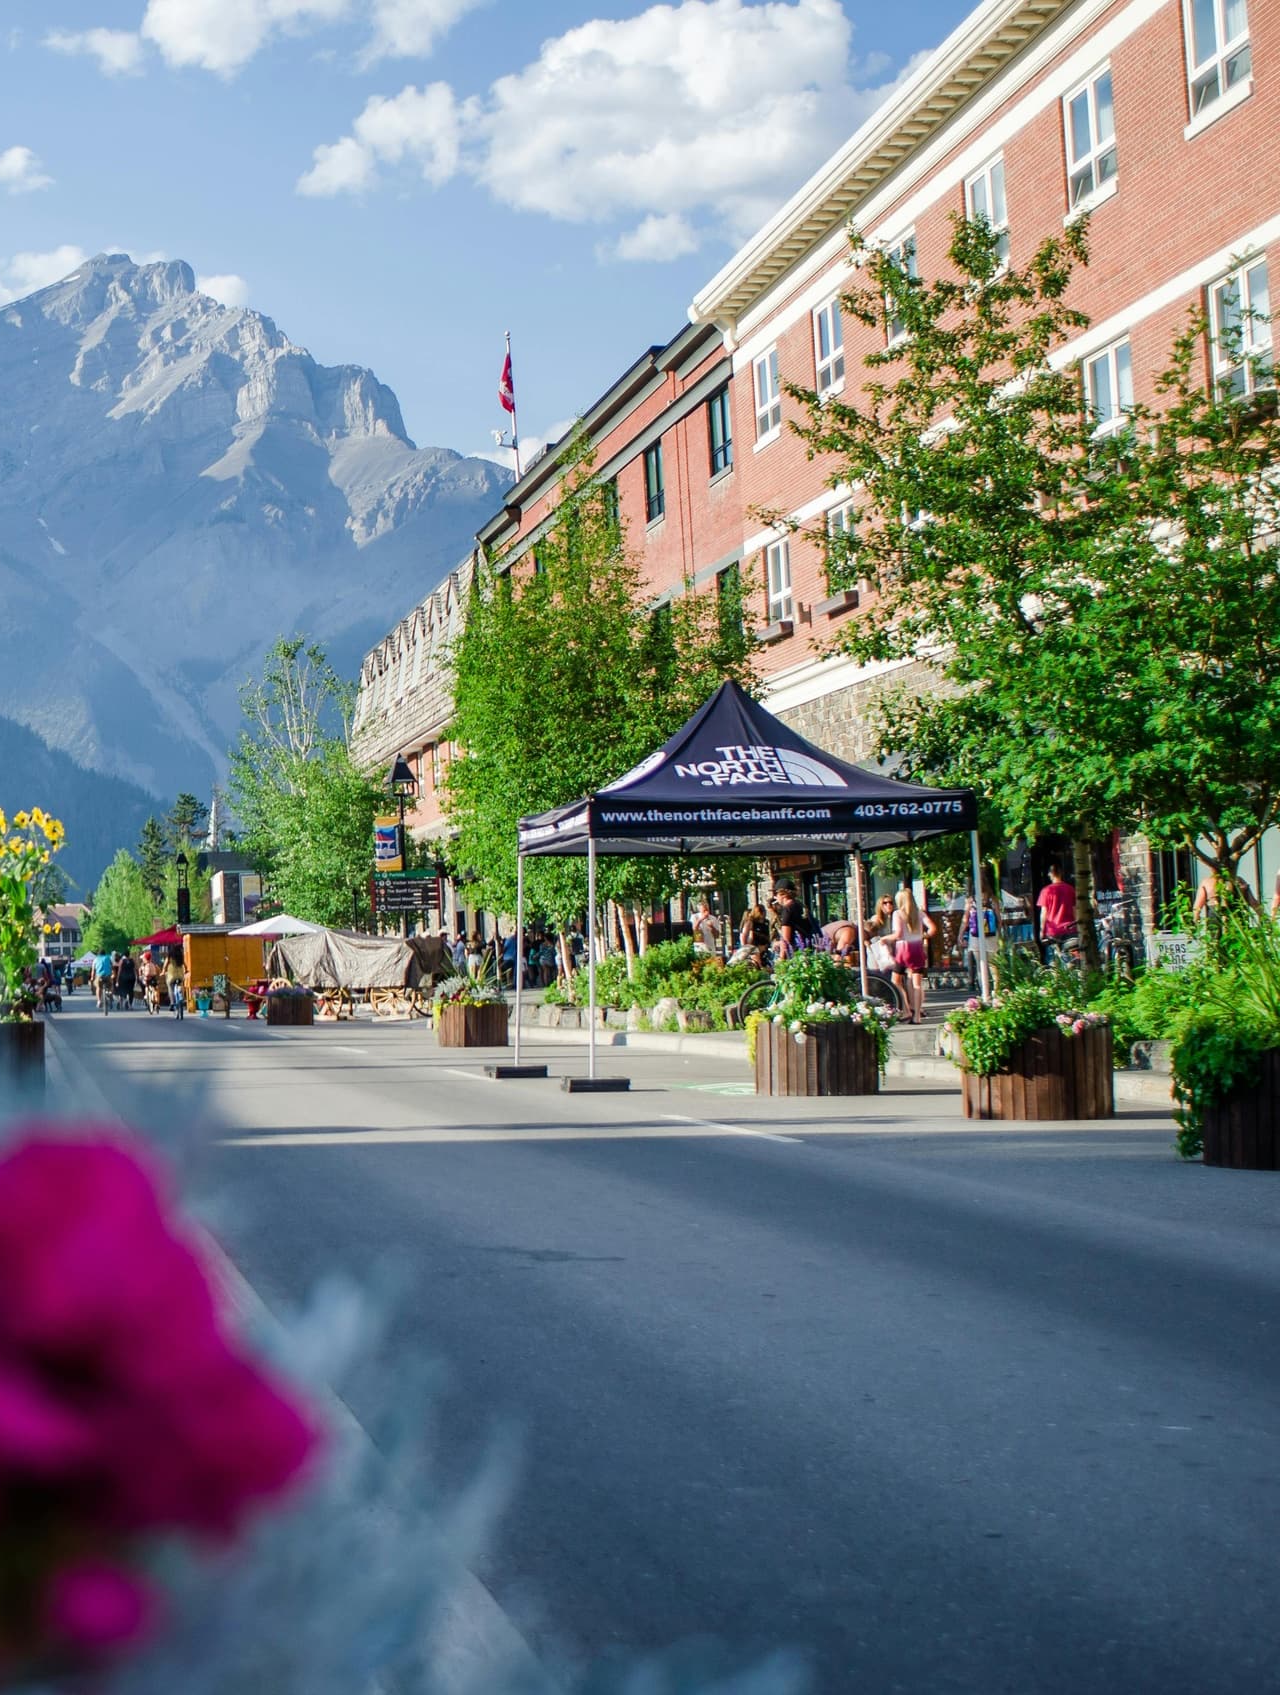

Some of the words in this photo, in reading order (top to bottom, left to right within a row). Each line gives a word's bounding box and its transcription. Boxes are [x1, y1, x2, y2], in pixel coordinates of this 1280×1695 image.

[715, 746, 774, 761] THE
[674, 759, 785, 776] NORTH
[709, 771, 791, 786] FACE
[601, 807, 831, 822] www.thenorthfacebanff.com
[854, 800, 962, 817] 403-762-0775
